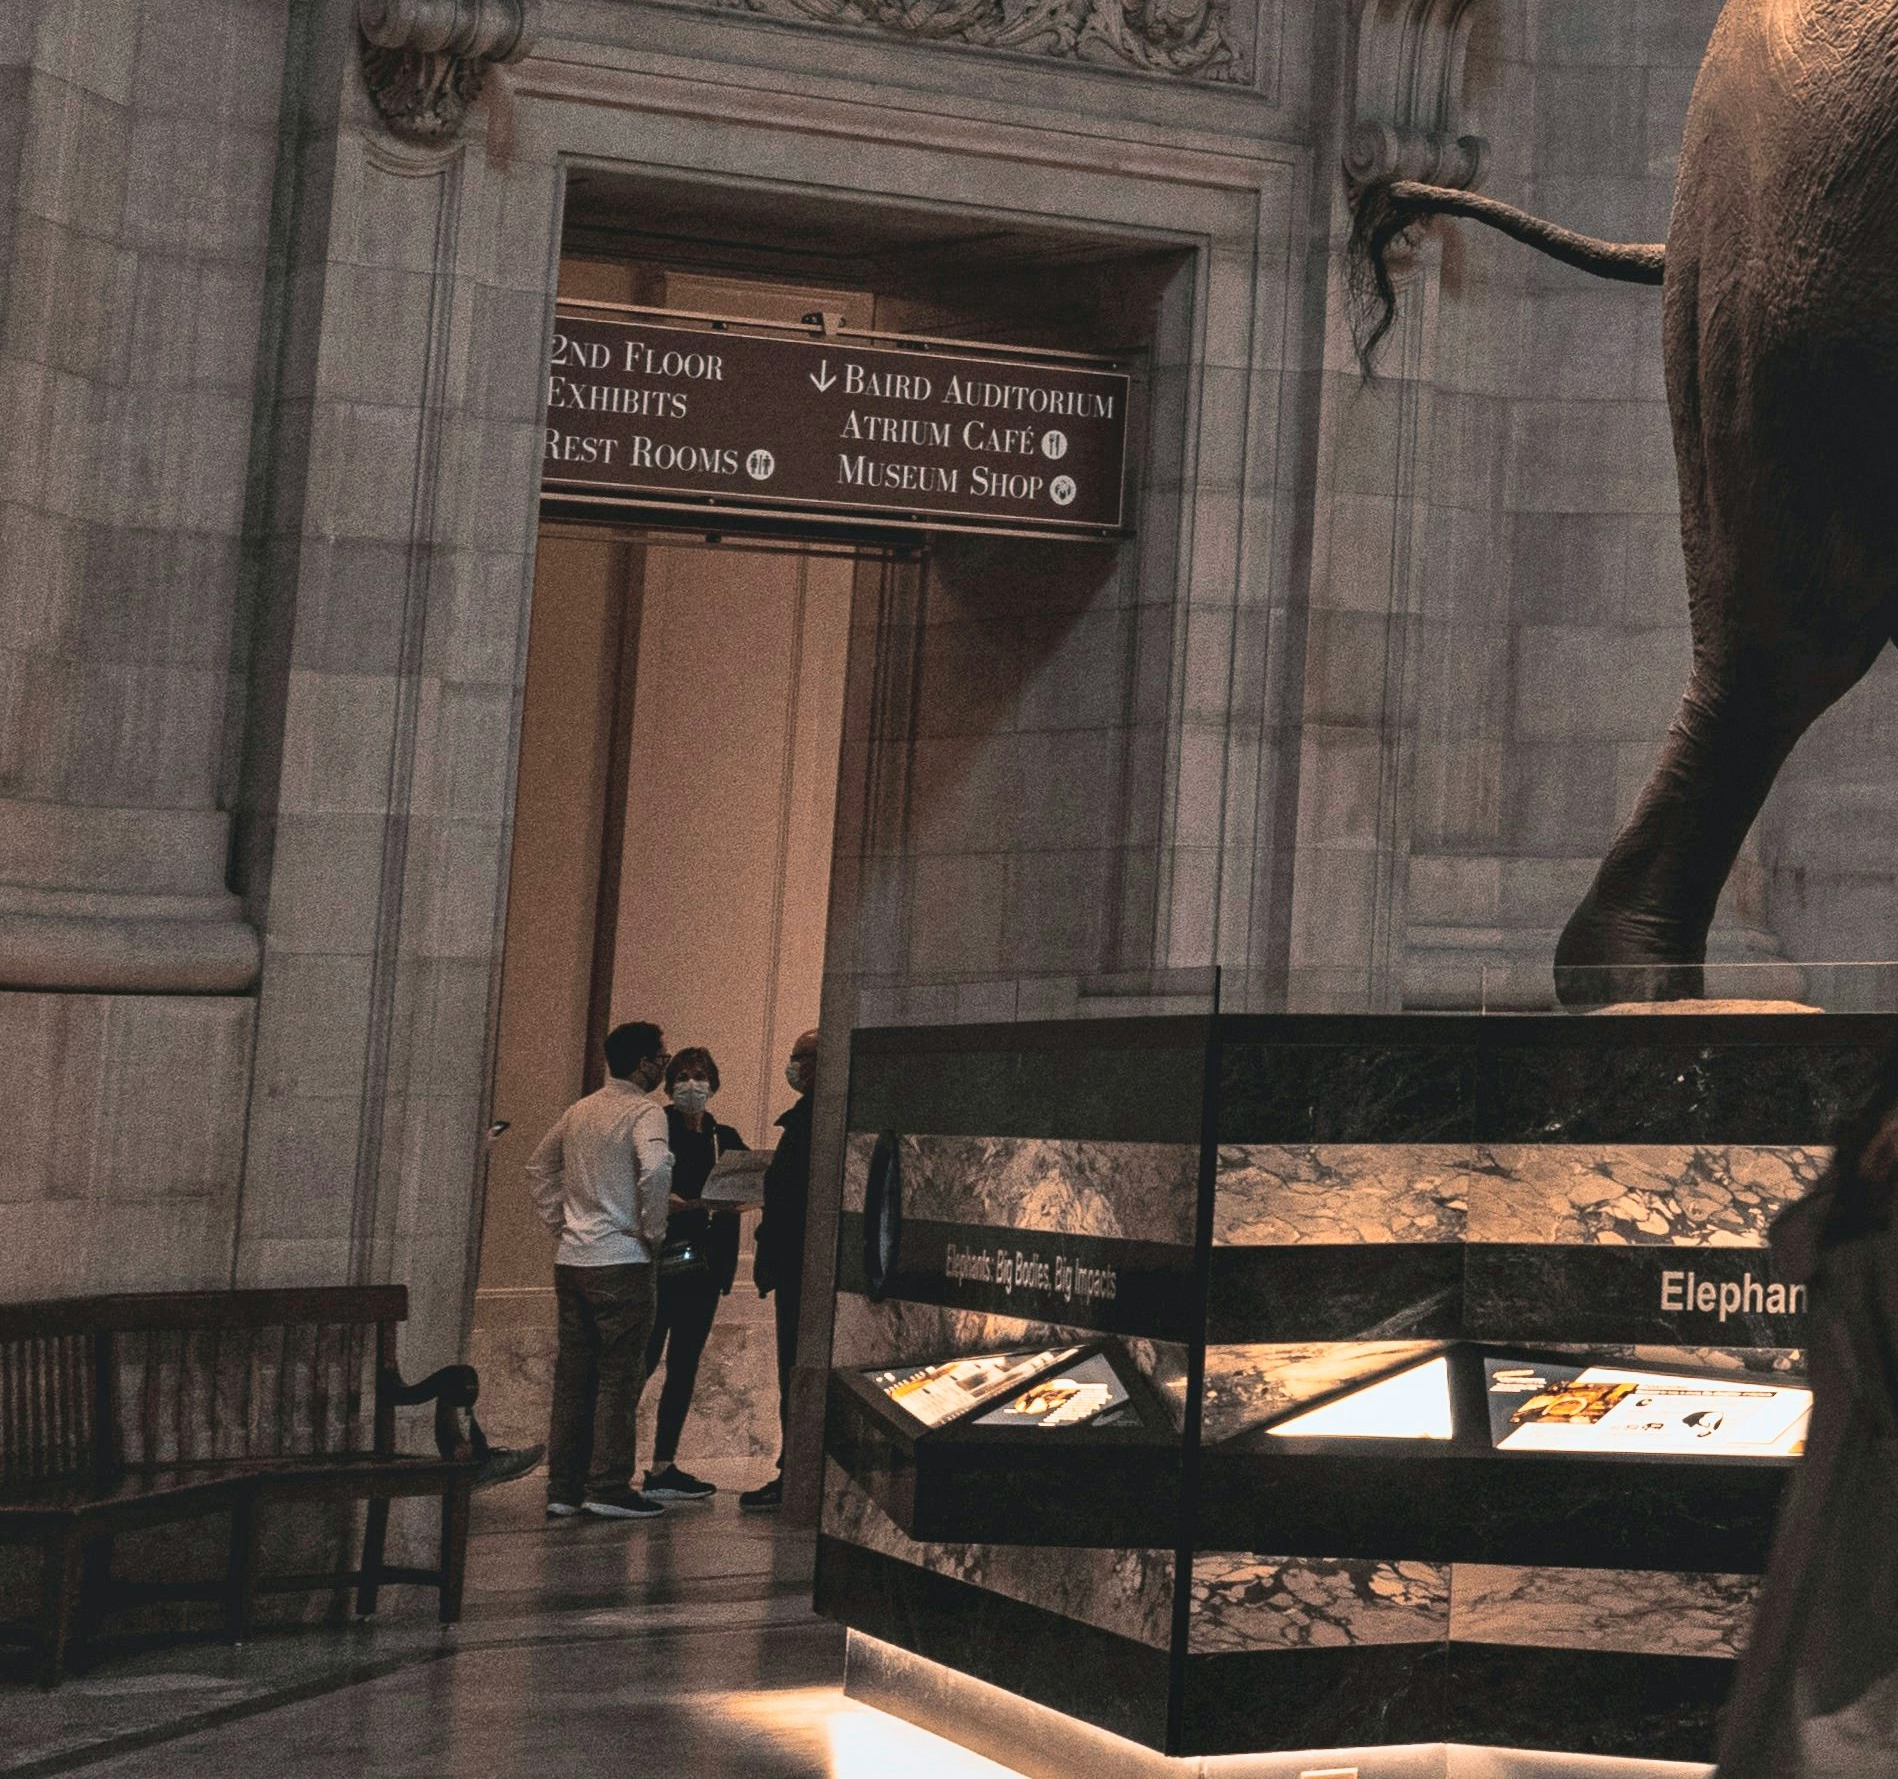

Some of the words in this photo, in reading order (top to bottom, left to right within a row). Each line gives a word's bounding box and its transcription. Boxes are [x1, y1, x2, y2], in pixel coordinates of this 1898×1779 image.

[551, 334, 611, 369] 2ND
[624, 341, 724, 381] FLOOR
[547, 376, 688, 419] EXHIBITS
[844, 363, 932, 401] BAIRD
[942, 374, 1115, 419] AUDITORIUM
[544, 428, 619, 465] REST
[629, 435, 739, 475] ROOMS
[840, 409, 951, 447] ATRIUM
[963, 420, 1035, 455] CAFÉ
[838, 453, 958, 493] MUSEUM
[969, 466, 1044, 500] SHOP
[1661, 1270, 1808, 1322] Elephan
